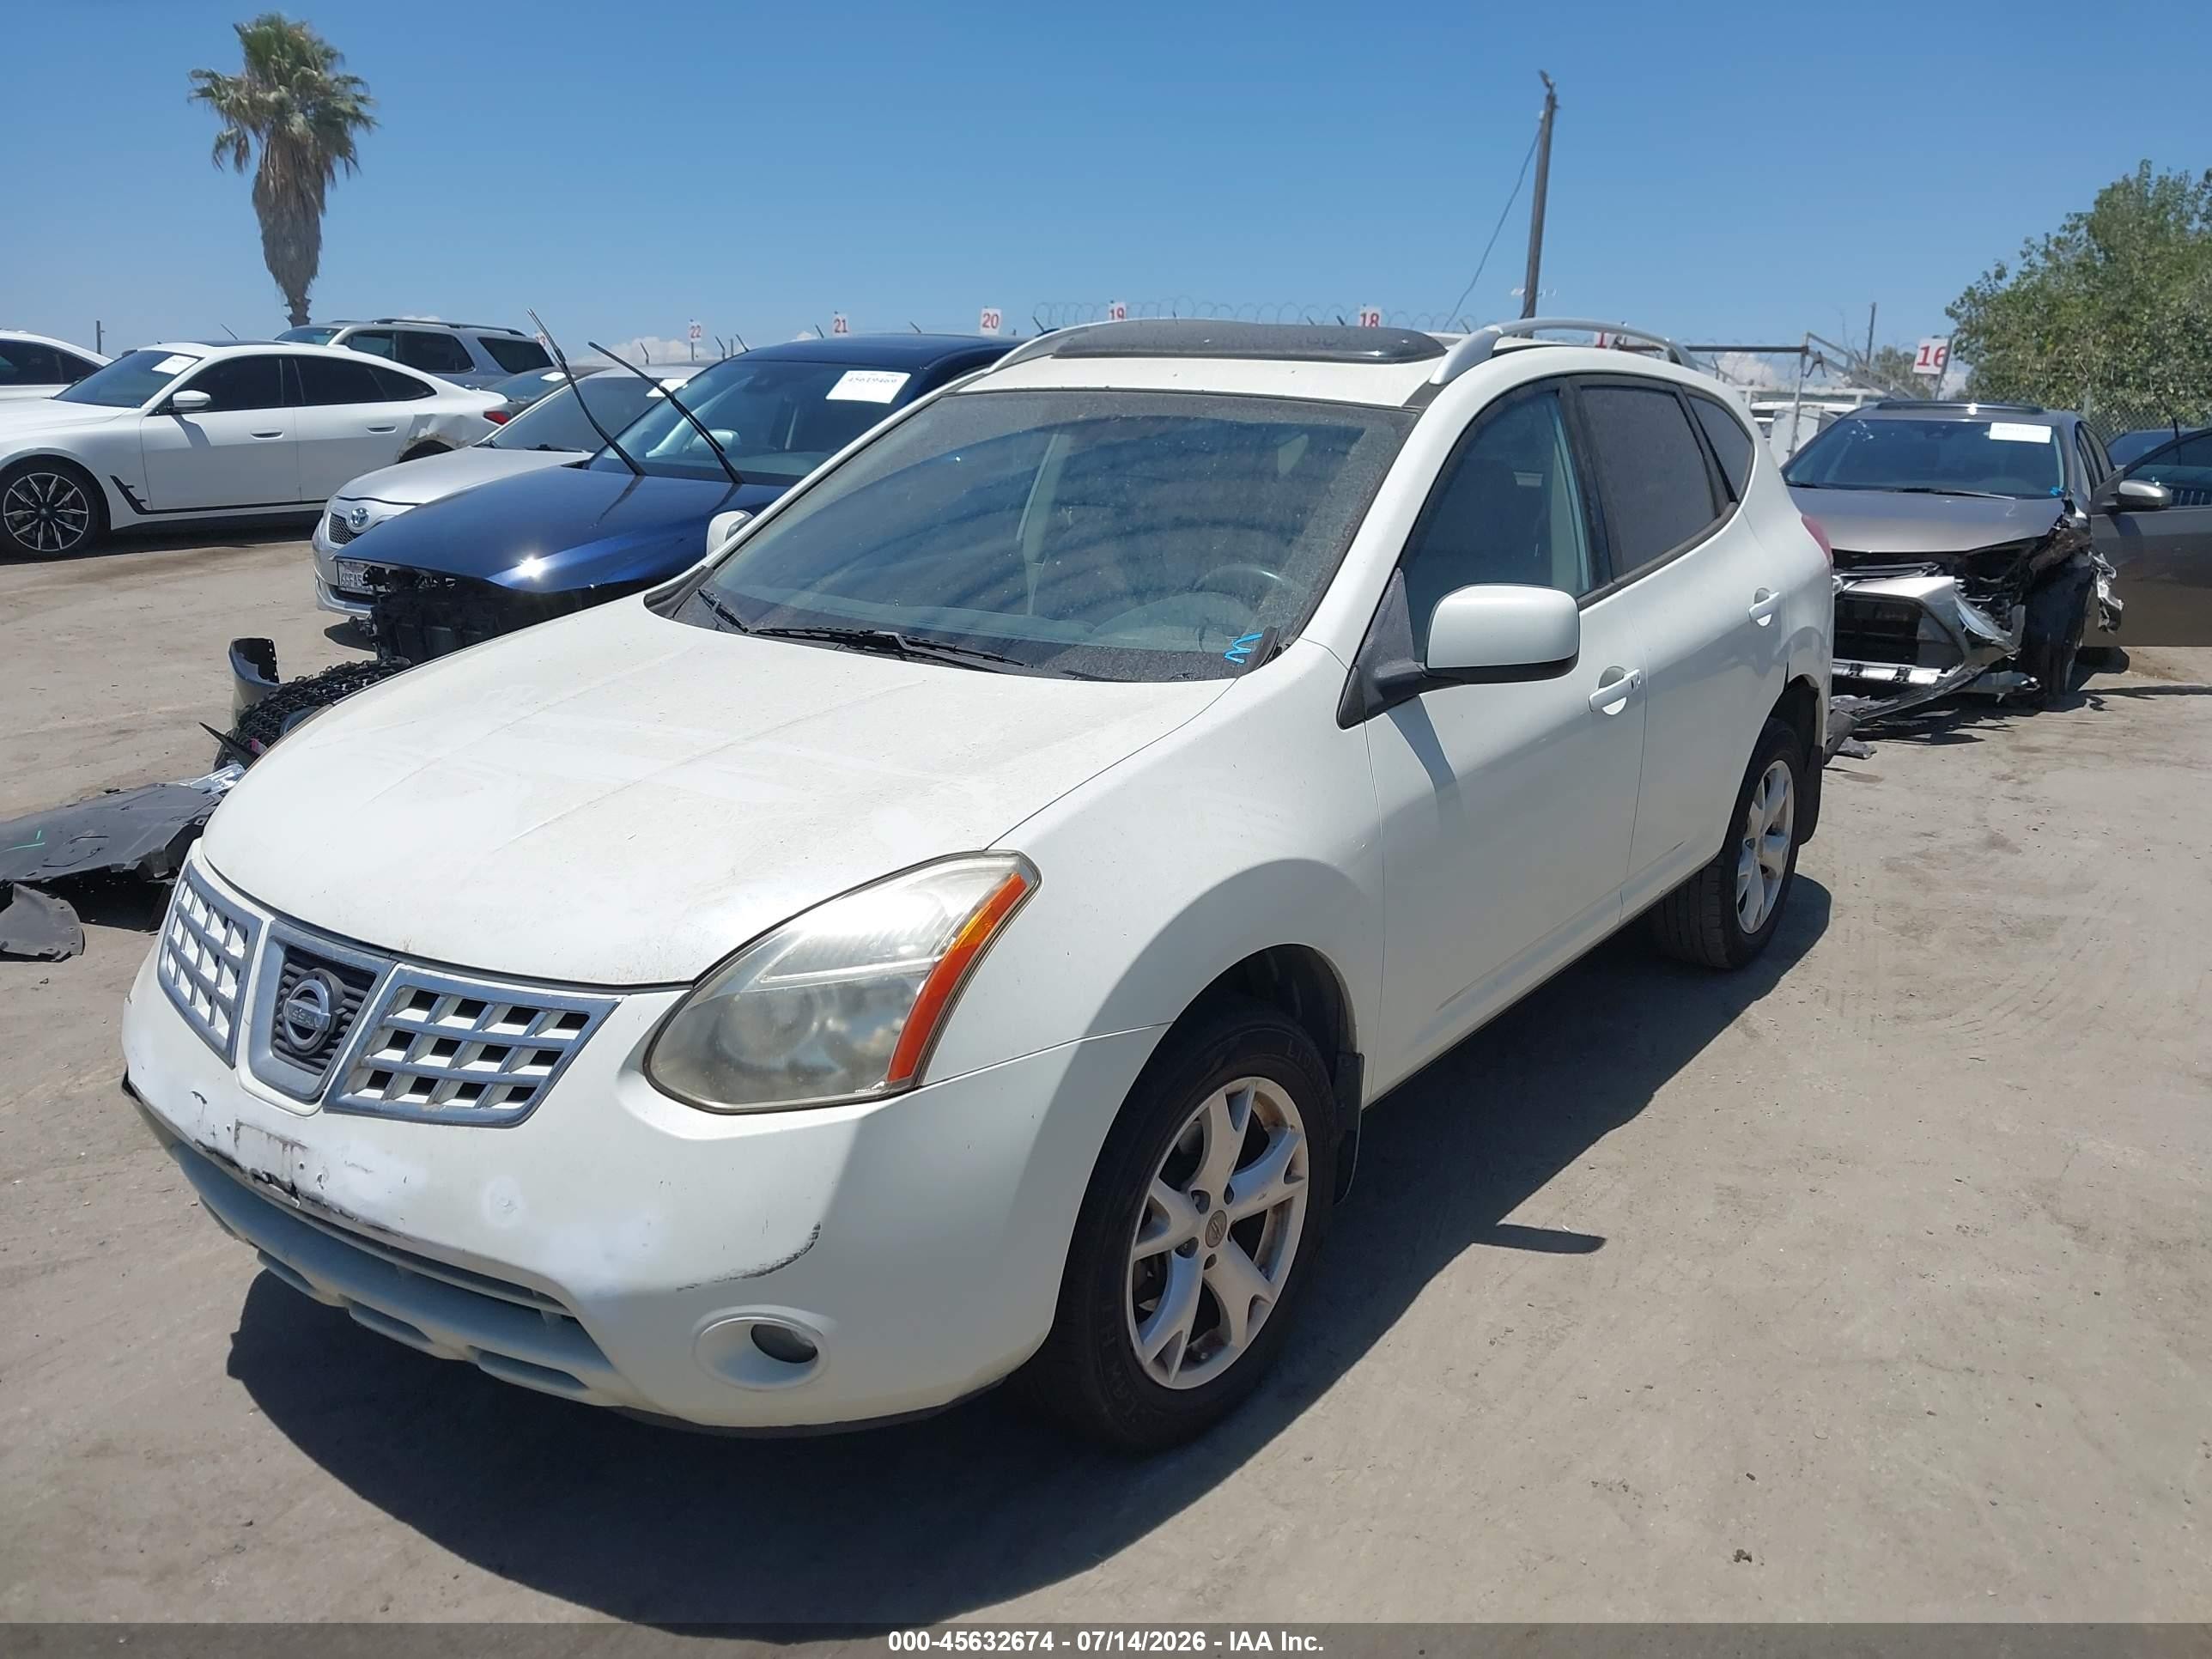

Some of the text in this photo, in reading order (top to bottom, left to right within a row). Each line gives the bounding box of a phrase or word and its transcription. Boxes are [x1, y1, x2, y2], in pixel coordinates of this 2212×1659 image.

[834, 318, 848, 333] 21
[981, 313, 1000, 329] 20
[1360, 313, 1379, 327] 18
[690, 325, 702, 338] 22
[1917, 345, 1946, 368] 16
